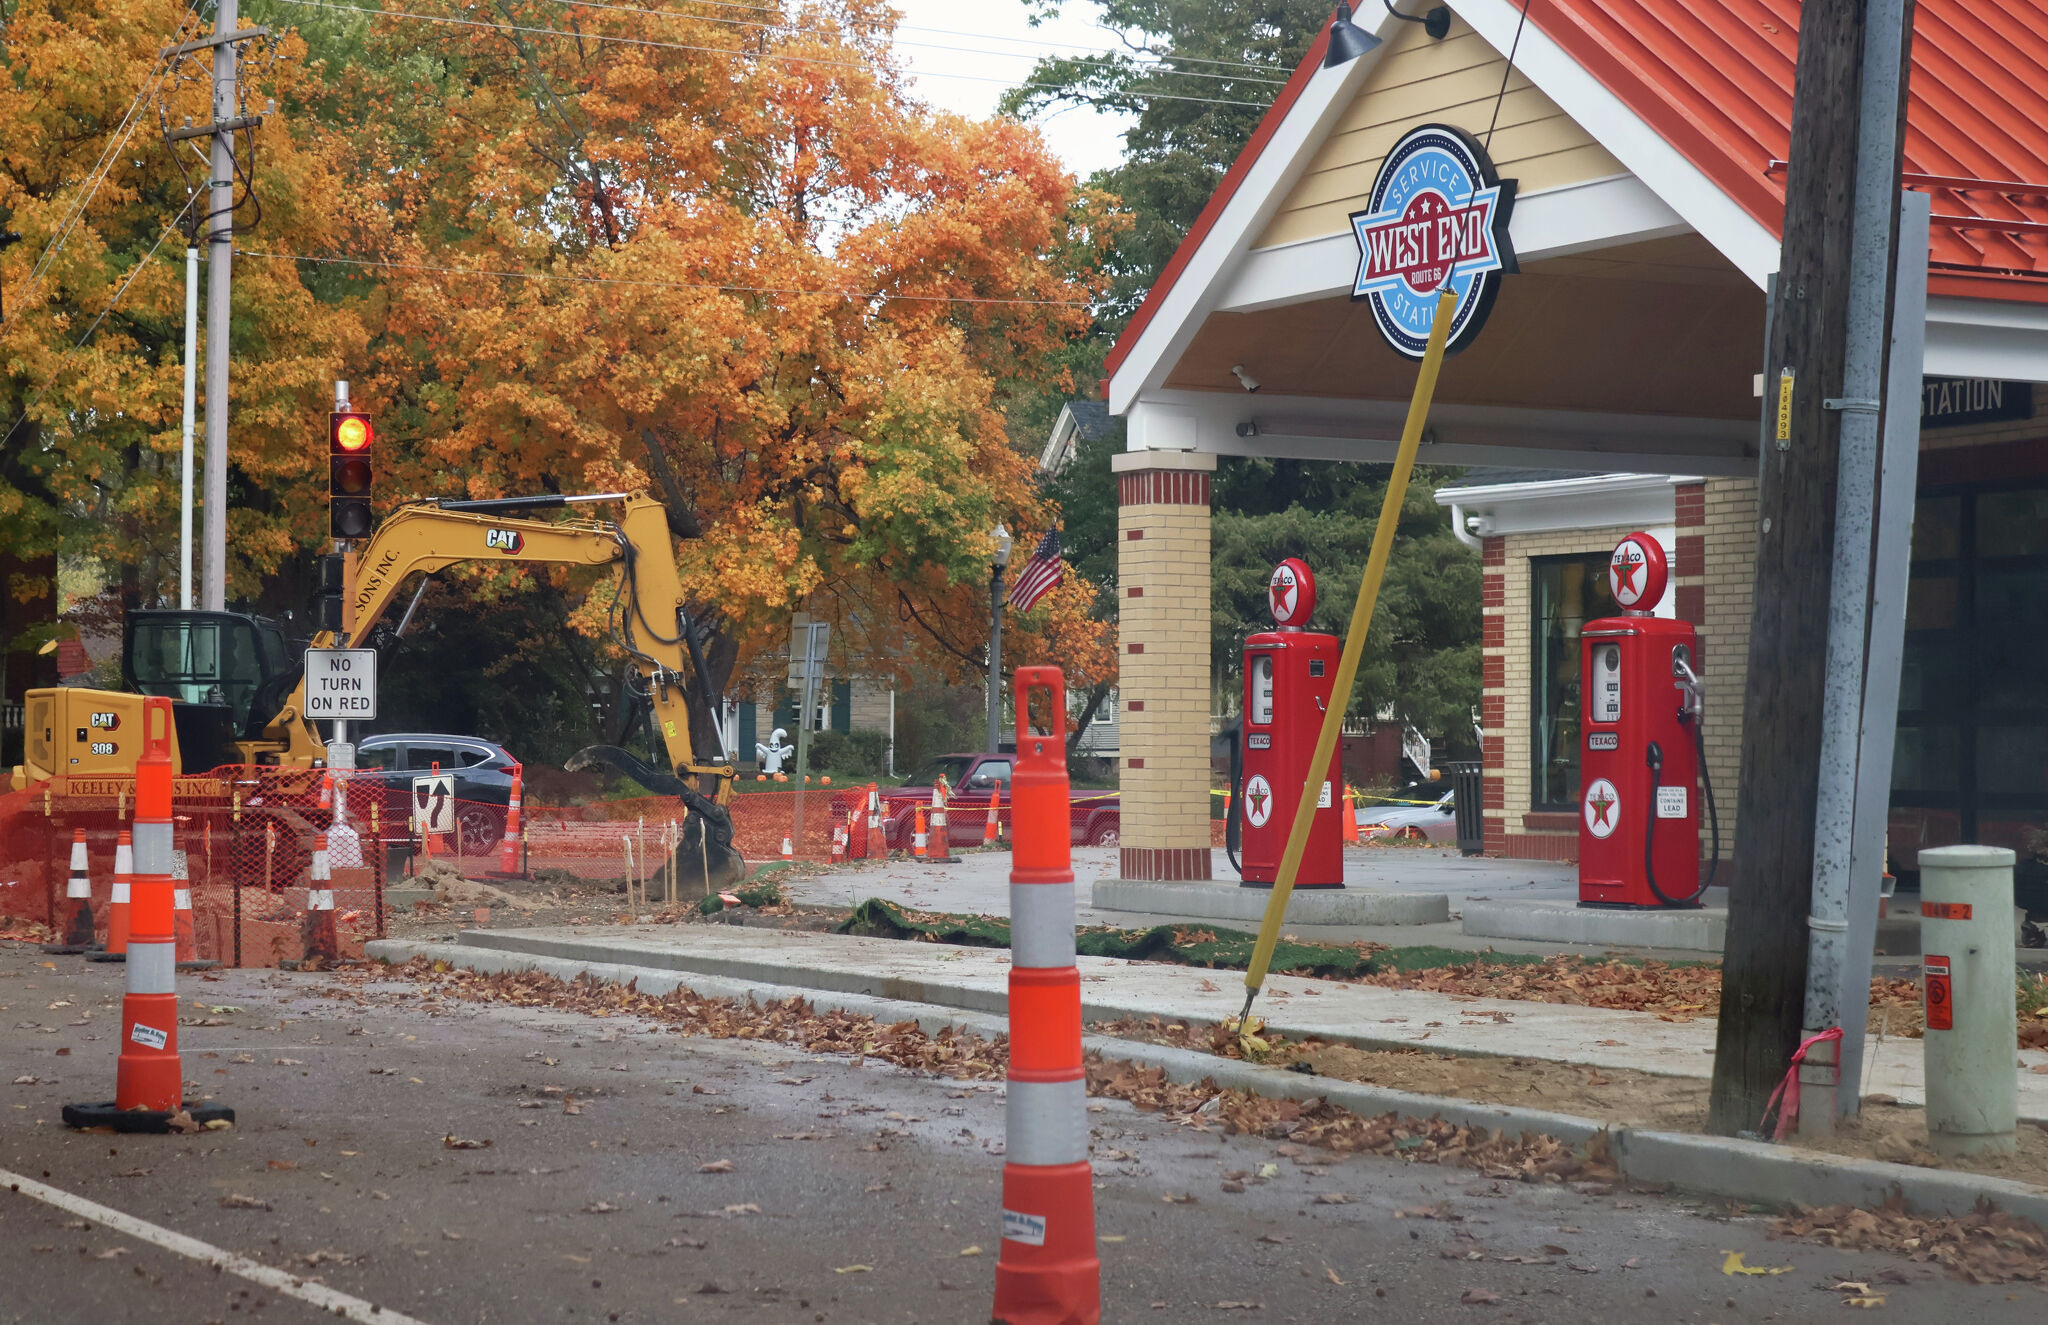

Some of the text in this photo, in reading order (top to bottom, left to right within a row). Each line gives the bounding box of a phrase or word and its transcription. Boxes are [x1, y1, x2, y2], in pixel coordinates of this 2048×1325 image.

[1392, 159, 1460, 205] SERVICE
[1370, 210, 1482, 273] WEST END
[1411, 268, 1442, 285] ROUTE 66
[1394, 292, 1440, 326] STATI
[486, 528, 517, 549] CAT
[1613, 553, 1641, 563] TEXACO
[355, 549, 401, 612] SONS INC.
[330, 658, 351, 672] NO
[320, 678, 361, 691] TURN
[311, 697, 370, 710] ON RED
[91, 713, 114, 728] CAT
[91, 742, 113, 755] 308
[1250, 737, 1271, 746] TEXACO
[1591, 737, 1618, 746] TEXACO
[71, 781, 123, 795] KEELEY
